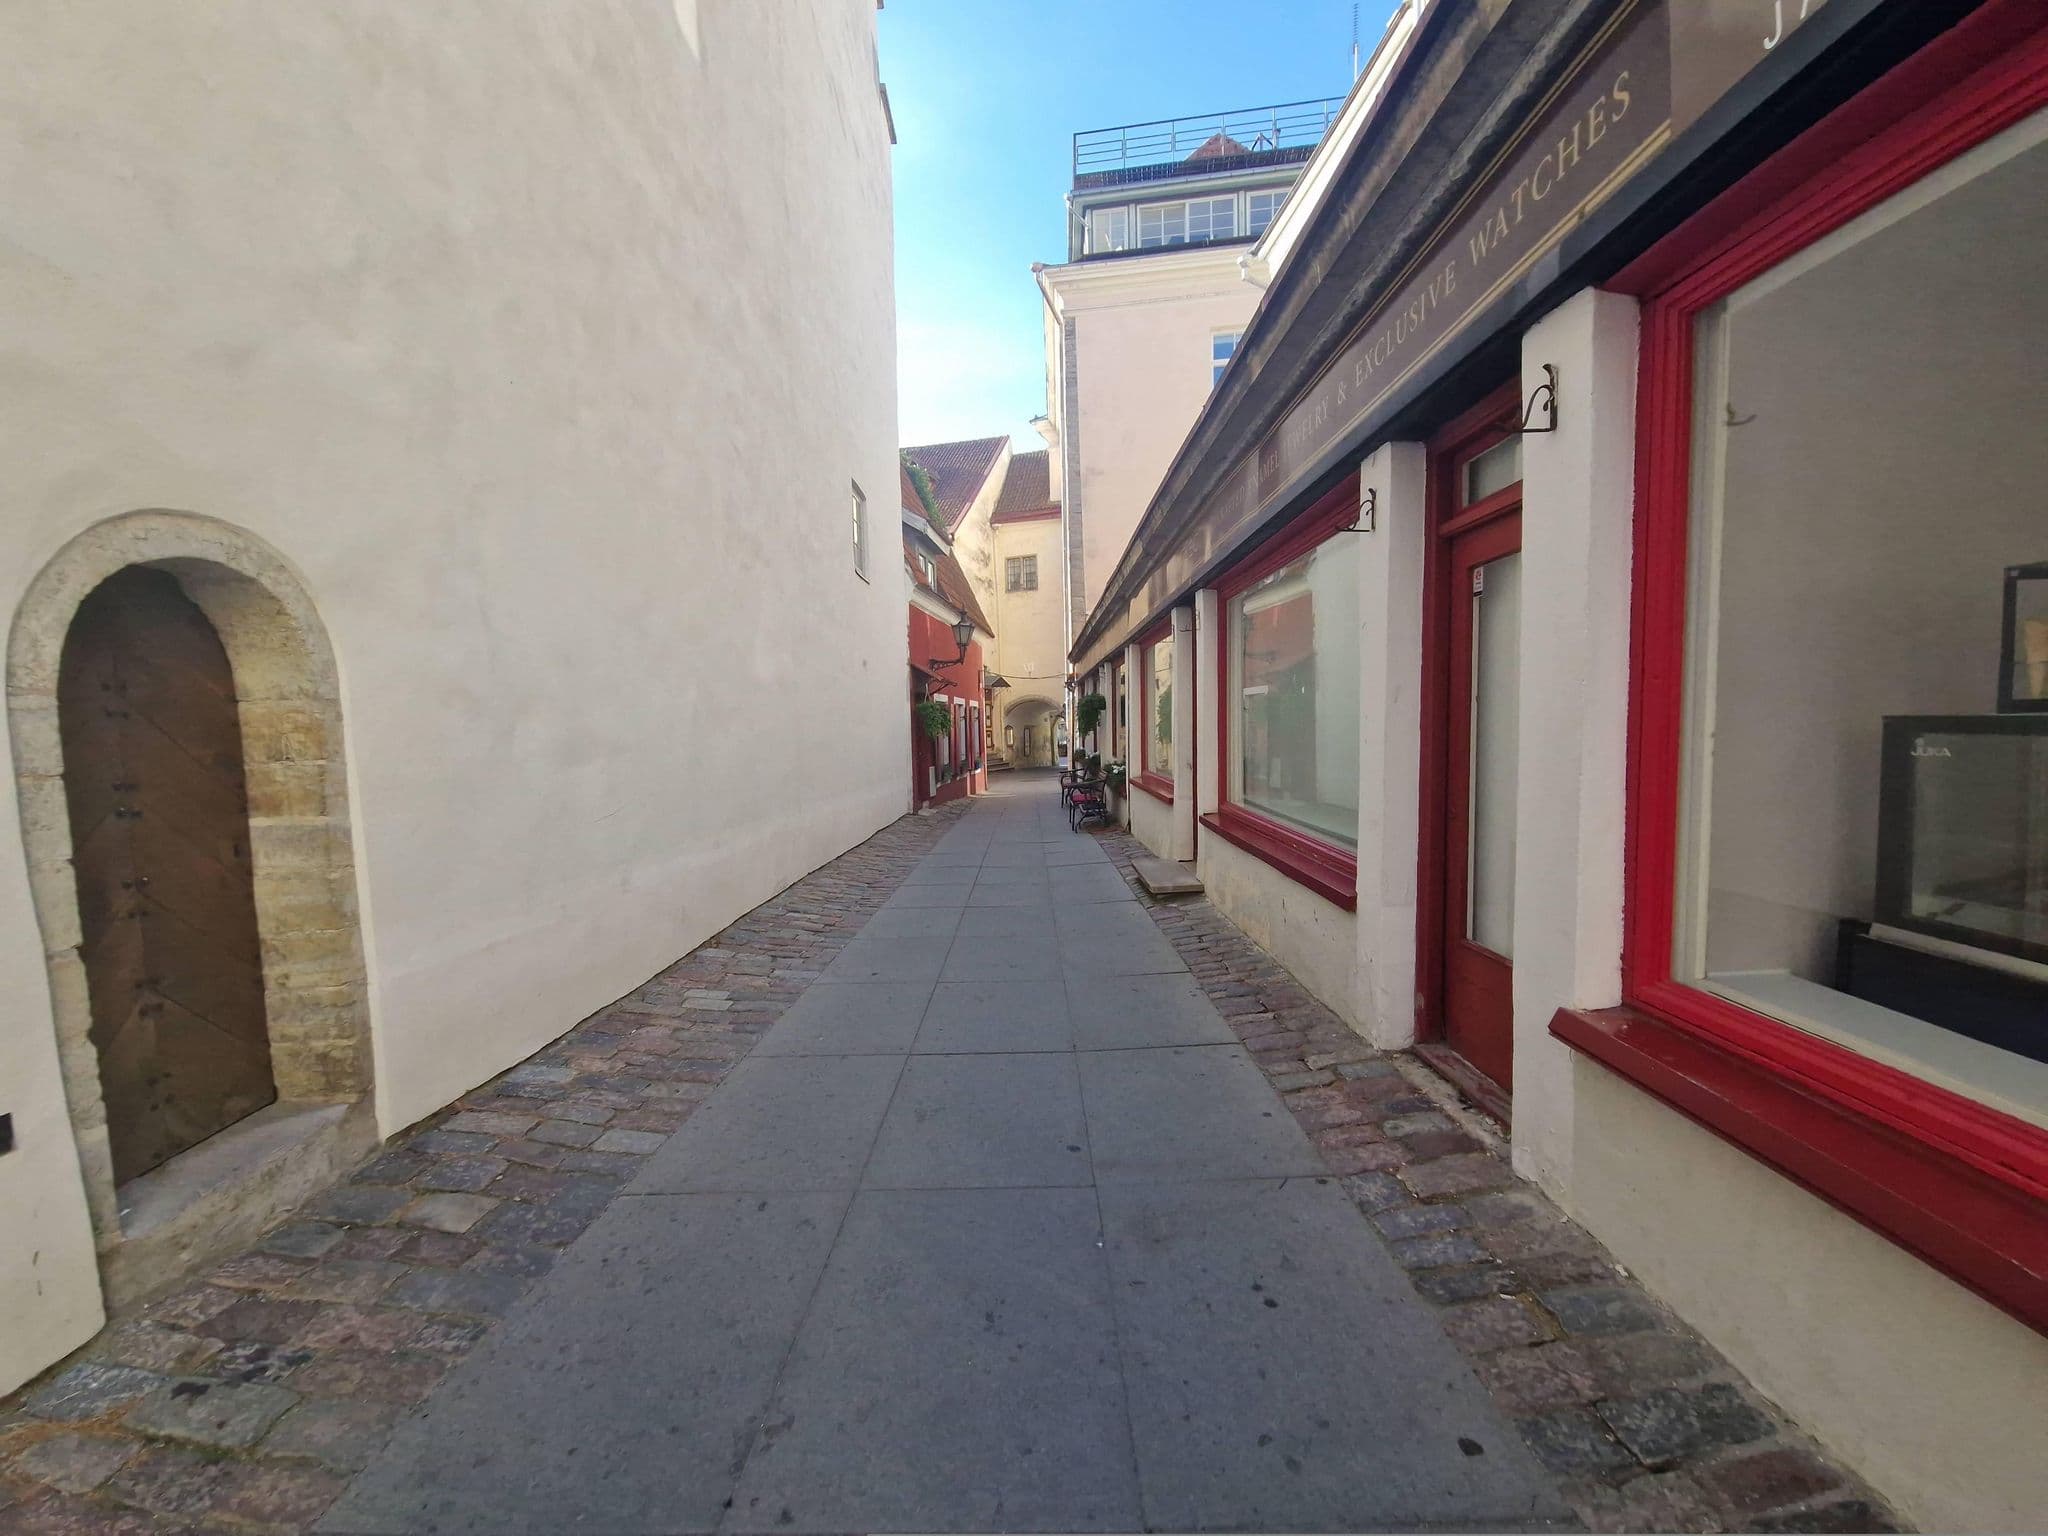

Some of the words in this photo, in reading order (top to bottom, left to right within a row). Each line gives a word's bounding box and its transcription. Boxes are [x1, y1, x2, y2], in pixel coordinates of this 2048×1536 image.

[1337, 381, 1347, 405] &
[1355, 259, 1457, 388] EXCLUSIVE
[1469, 70, 1631, 266] WATCHES
